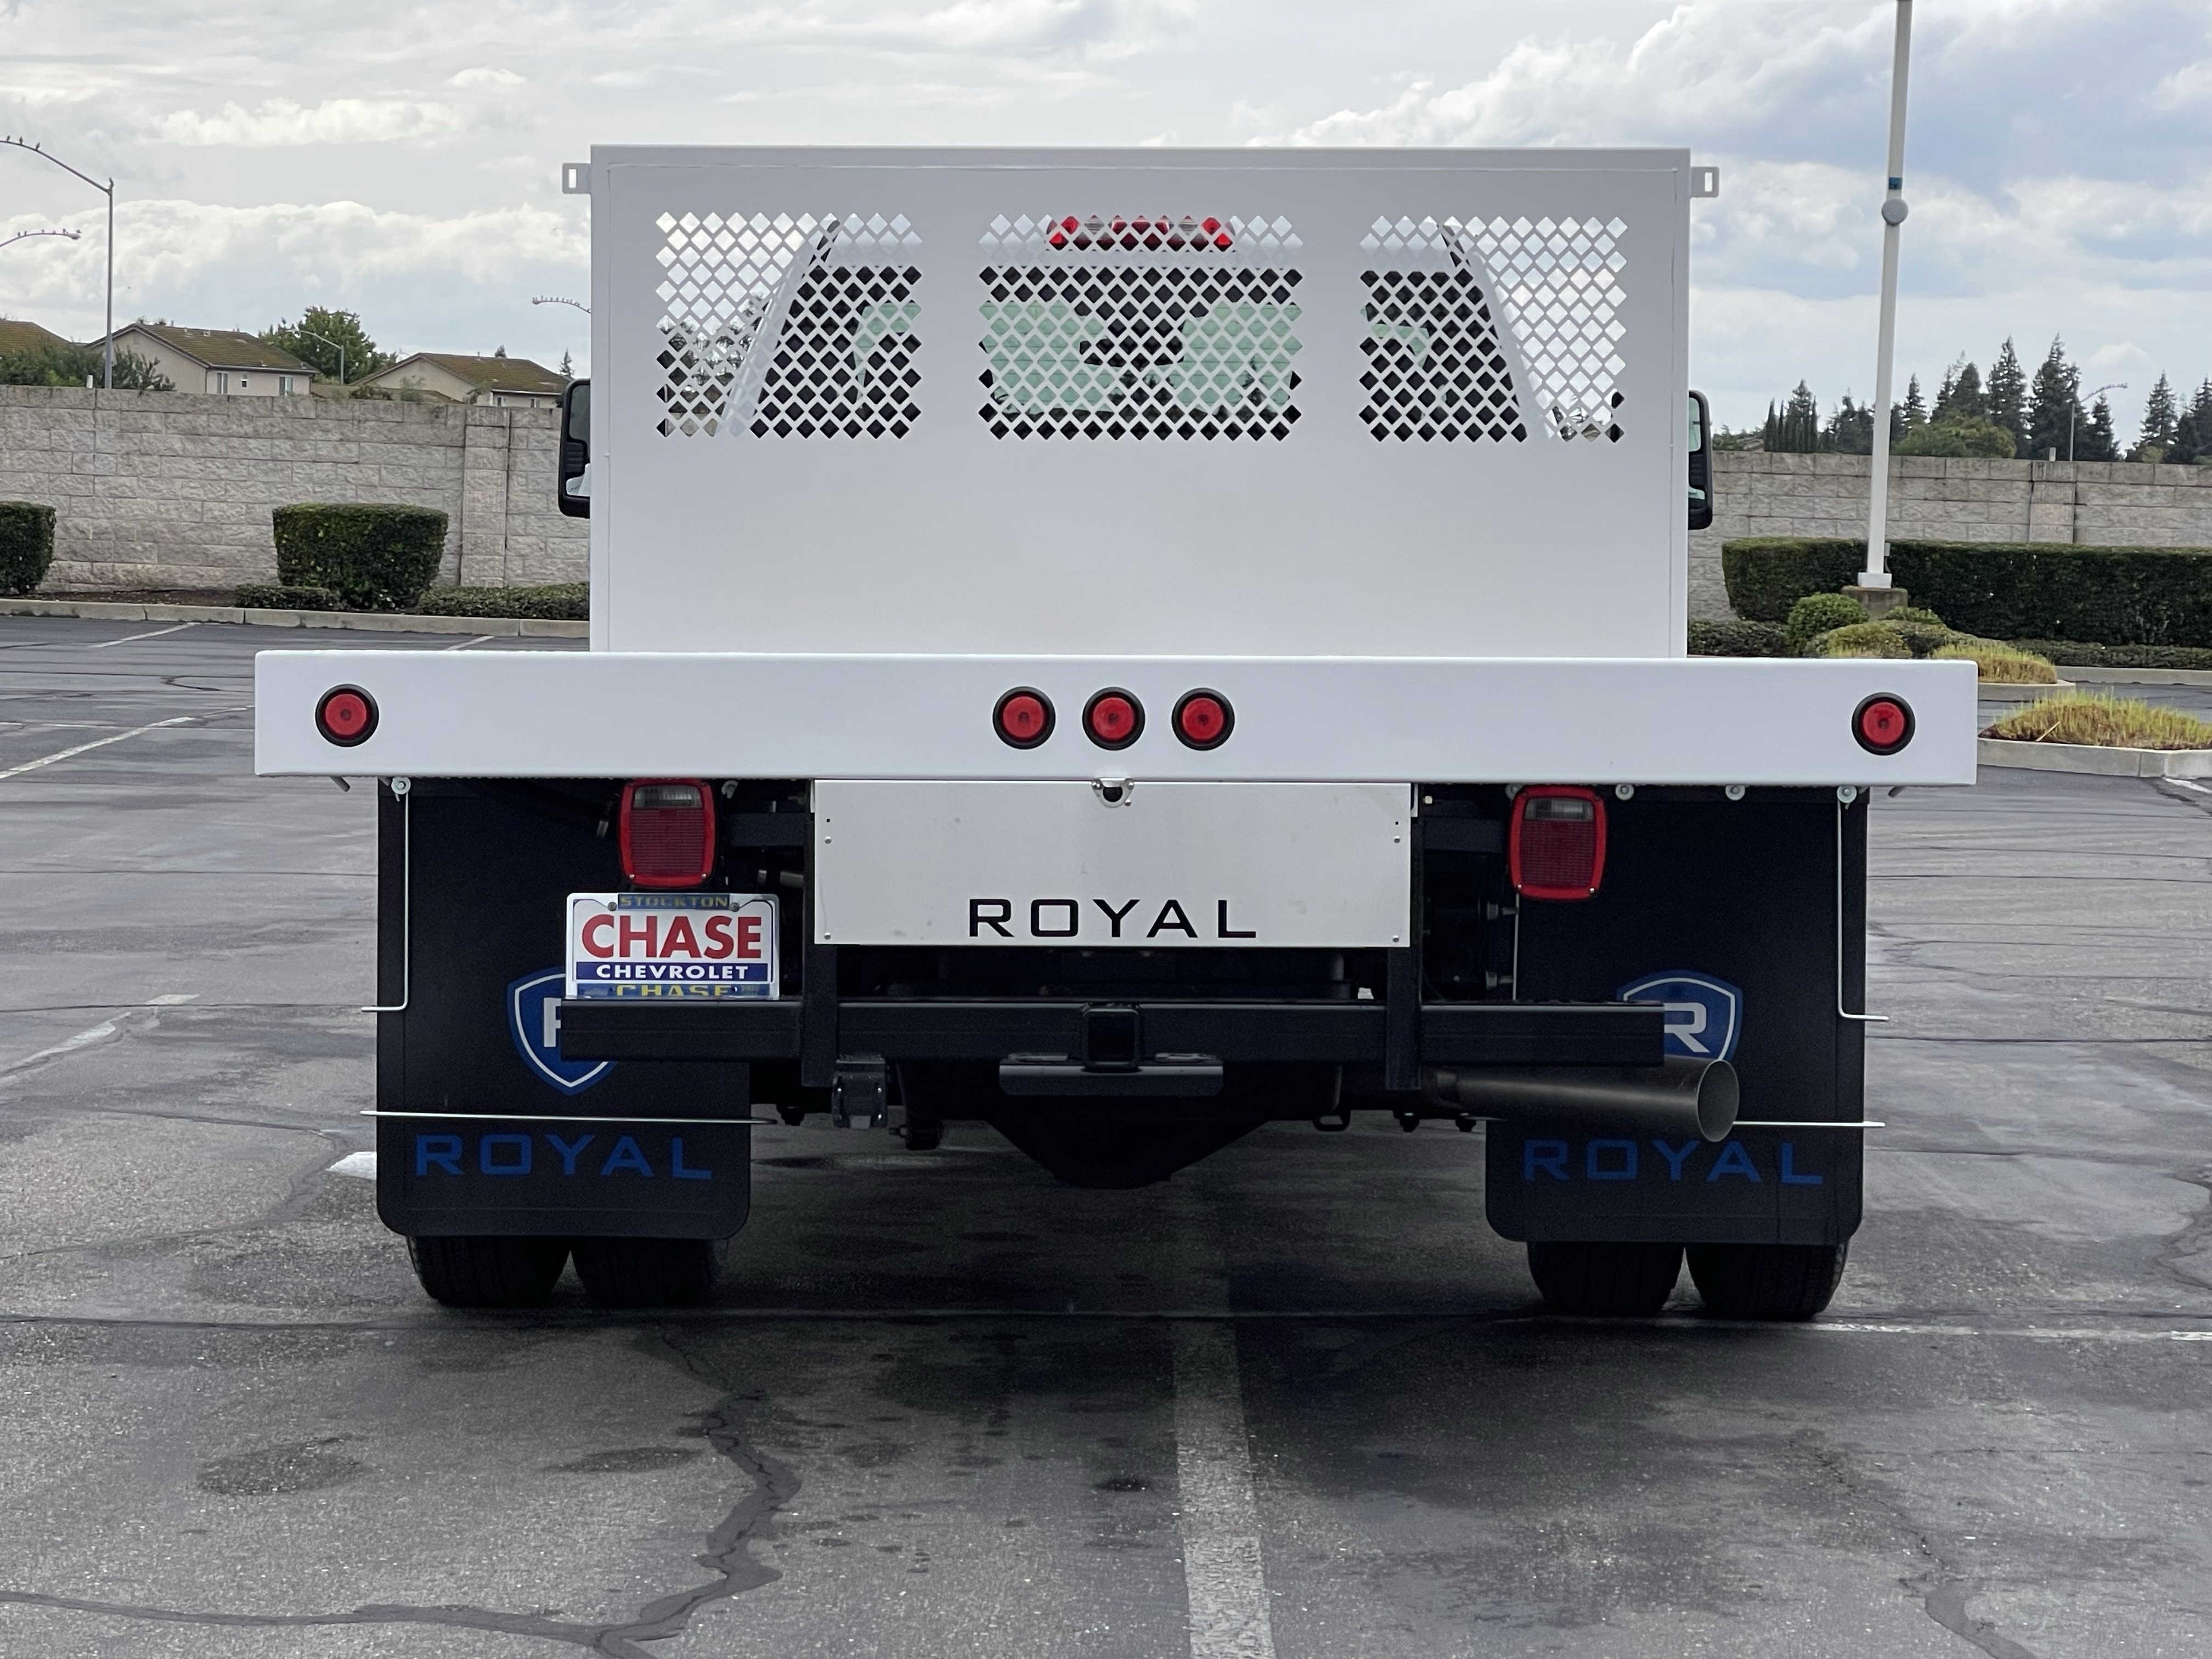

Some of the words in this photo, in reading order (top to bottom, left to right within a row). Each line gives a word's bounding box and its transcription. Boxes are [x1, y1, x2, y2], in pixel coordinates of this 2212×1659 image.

[620, 896, 728, 907] STOCKTON
[969, 899, 1256, 938] ROYAL
[582, 915, 761, 958] CHASE
[596, 964, 748, 979] CHEVROLET
[415, 1134, 712, 1178] ROYAL
[1523, 1140, 1822, 1184] ROYAL
